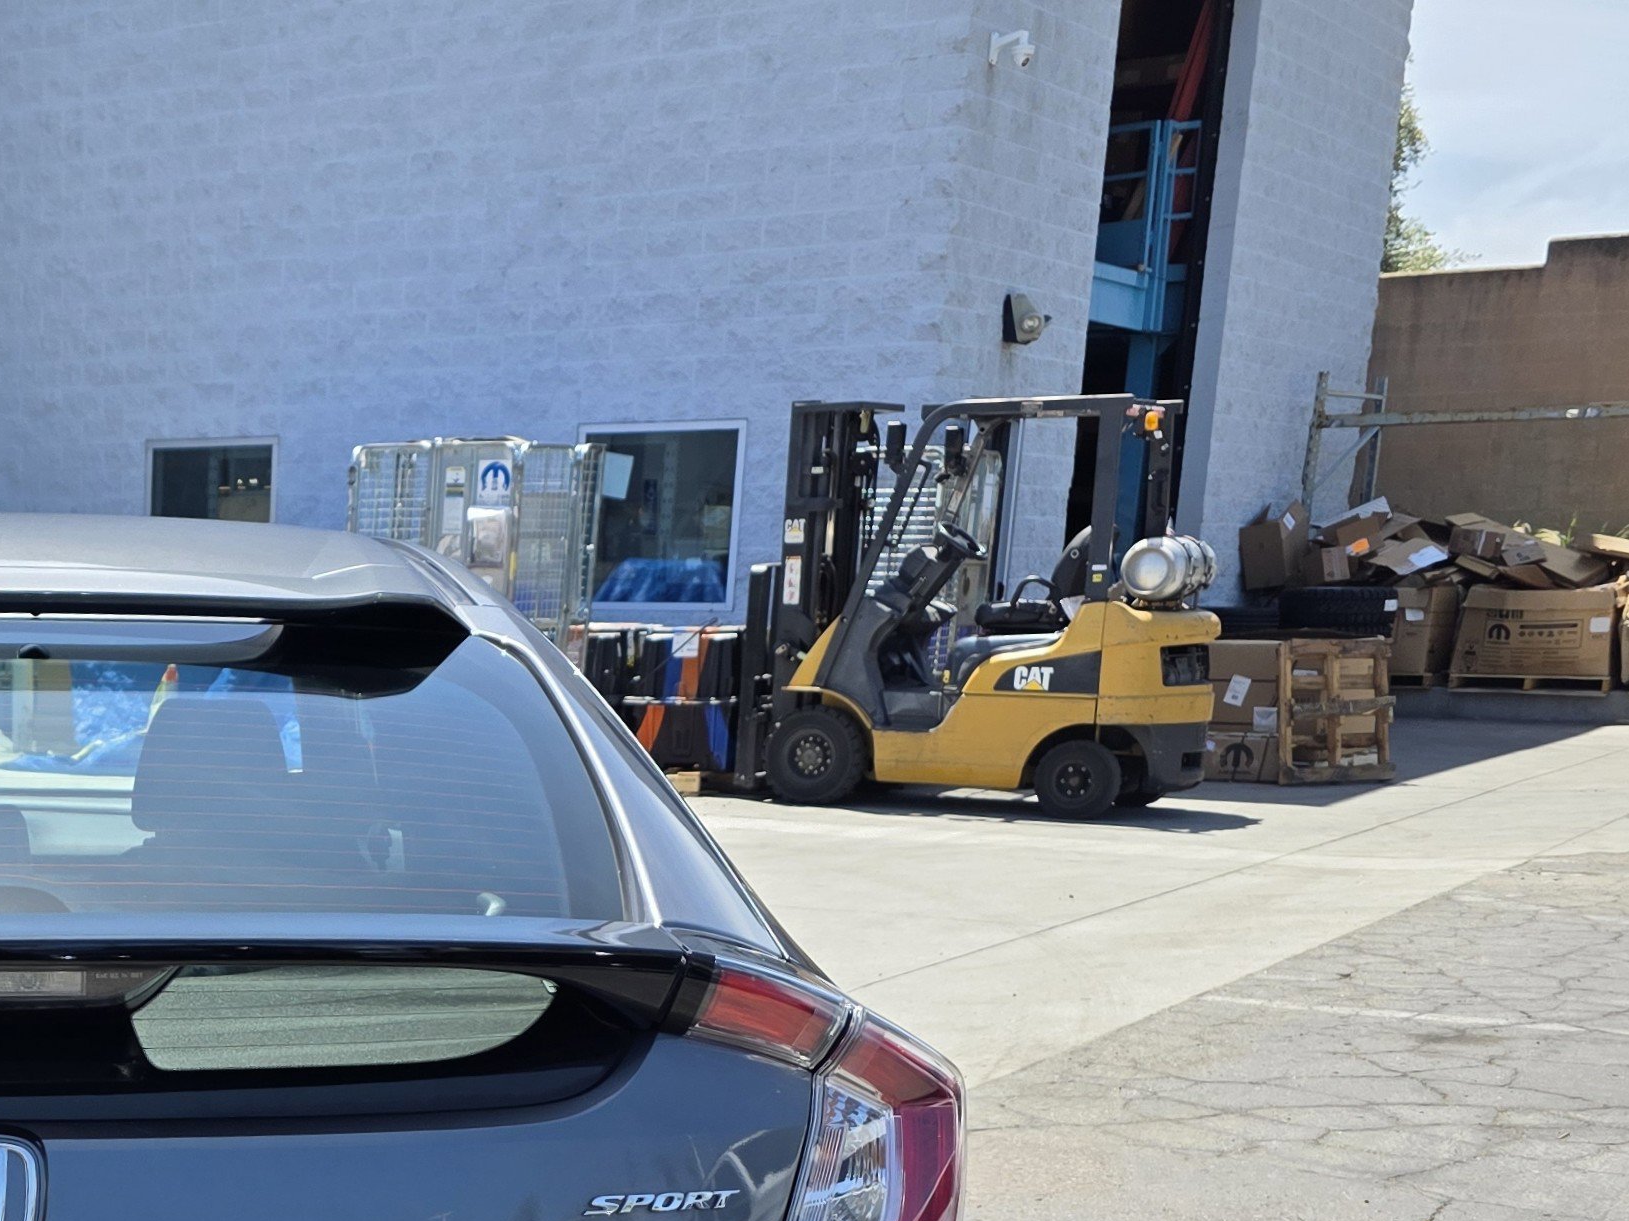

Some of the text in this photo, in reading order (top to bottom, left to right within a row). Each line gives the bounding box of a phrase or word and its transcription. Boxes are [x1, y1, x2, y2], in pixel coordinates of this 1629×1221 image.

[784, 518, 806, 532] CAT
[1013, 666, 1054, 691] CAT
[583, 1189, 741, 1216] SPORT
